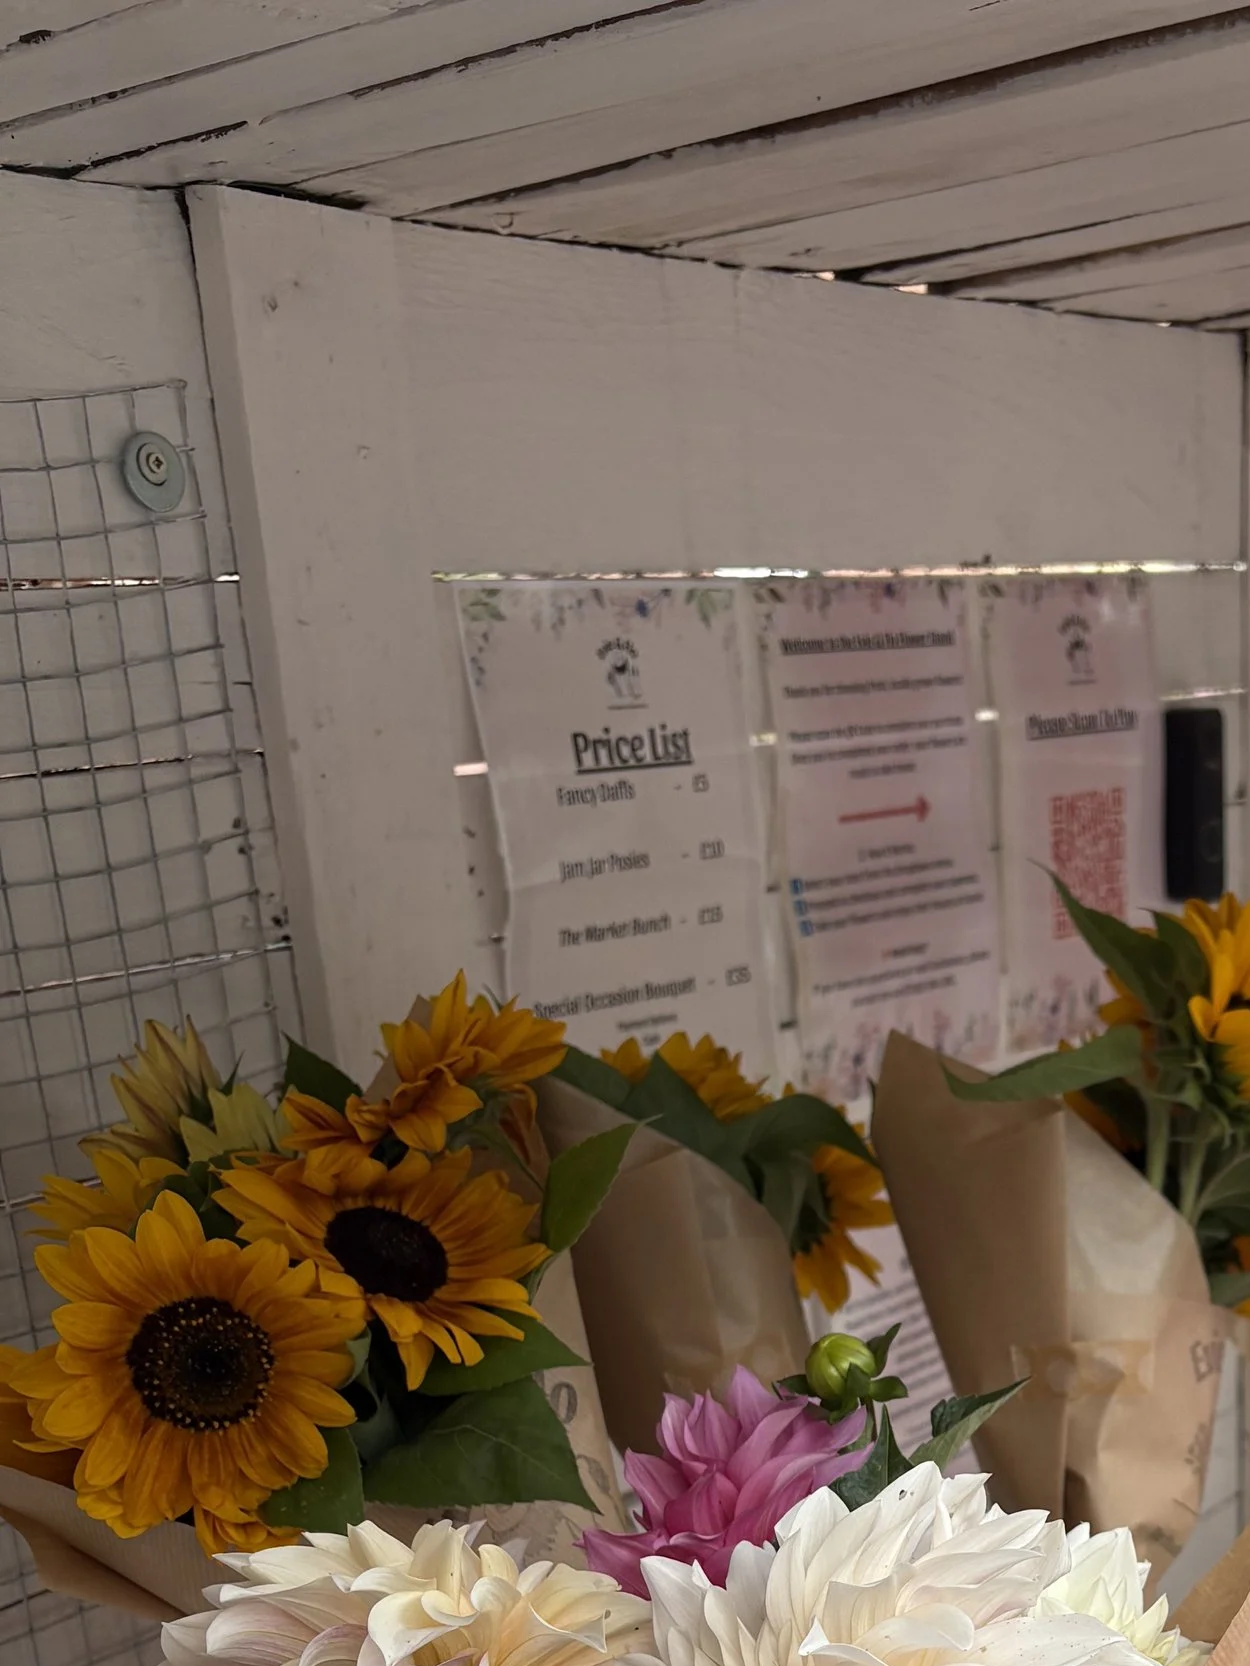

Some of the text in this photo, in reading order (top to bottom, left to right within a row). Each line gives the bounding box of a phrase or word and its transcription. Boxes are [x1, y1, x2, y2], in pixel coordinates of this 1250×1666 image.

[571, 723, 694, 768] Price List
[556, 785, 597, 808] Fancy
[597, 778, 636, 803] Daffs
[558, 859, 584, 885] Jam
[586, 856, 607, 880] Jar
[607, 849, 651, 874] Posies
[558, 927, 582, 948] The
[584, 920, 630, 943] Market
[631, 911, 672, 937] Bunch
[532, 996, 582, 1020] Special
[584, 985, 640, 1014] Occasion
[643, 976, 697, 1001] Bouquet
